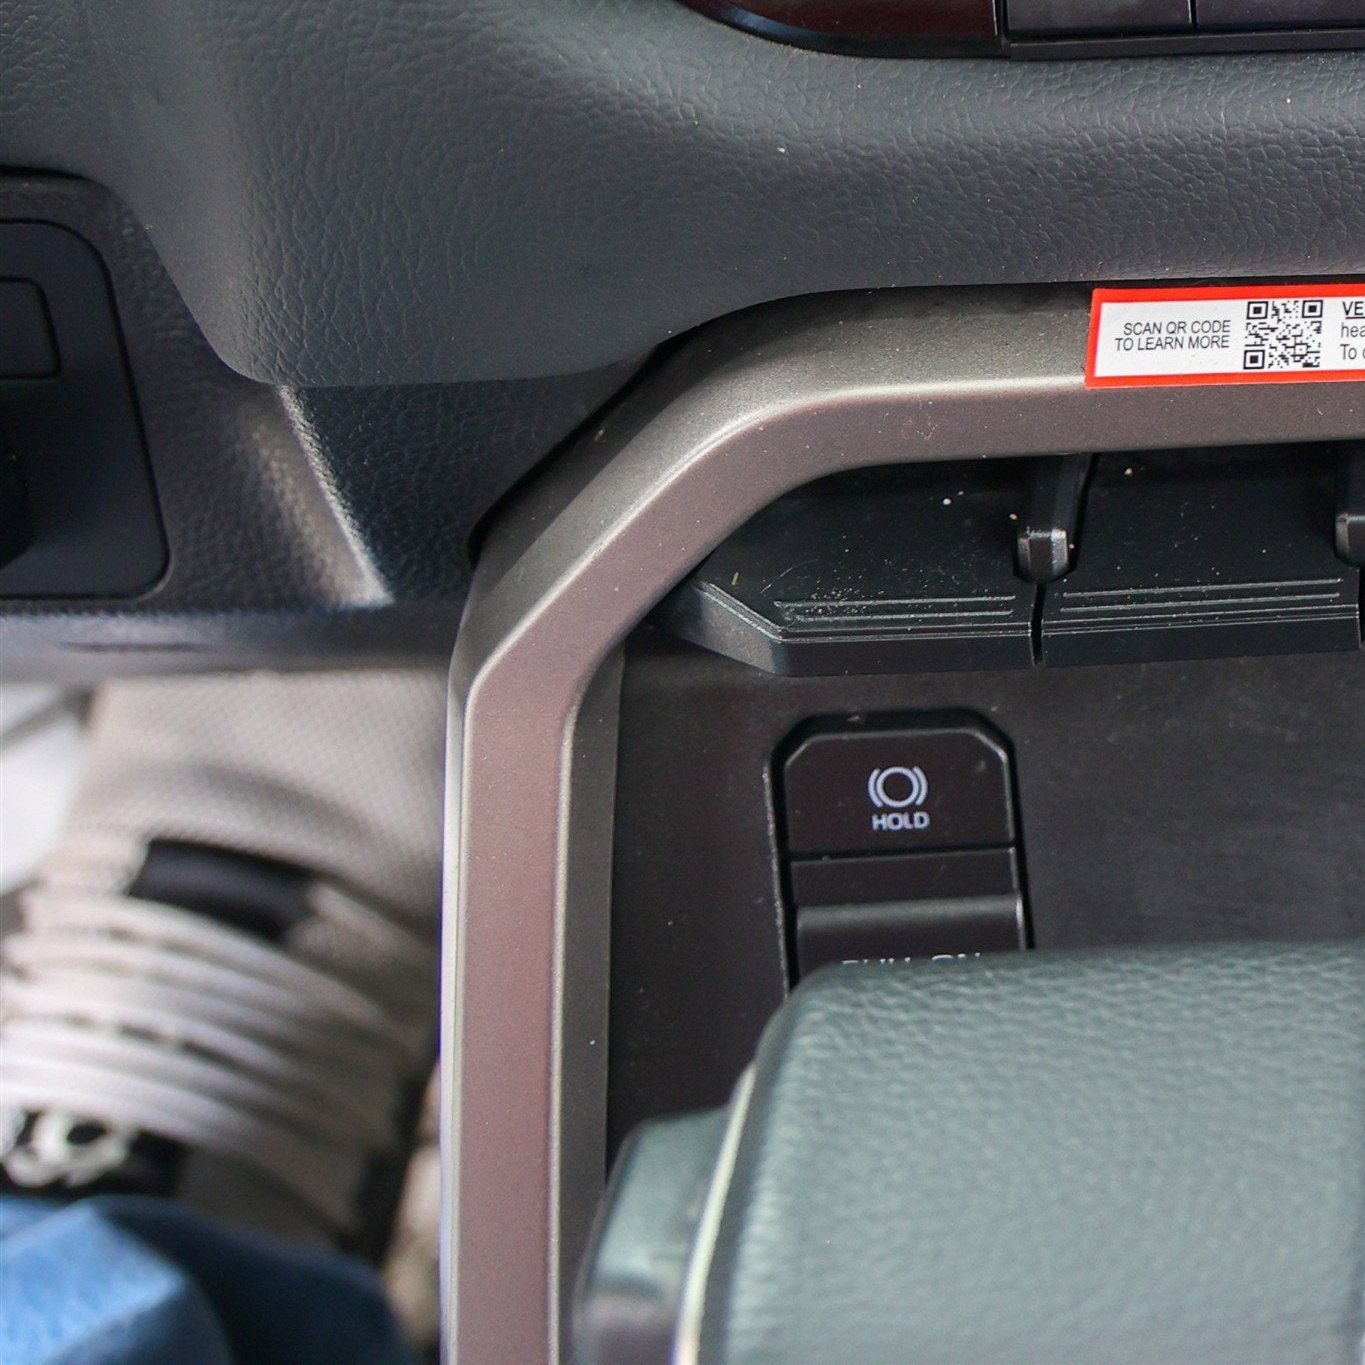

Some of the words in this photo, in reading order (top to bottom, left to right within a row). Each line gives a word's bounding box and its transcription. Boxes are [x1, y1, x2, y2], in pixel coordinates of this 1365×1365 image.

[1123, 321, 1162, 336] SCAN
[1165, 320, 1187, 334] QR
[1191, 319, 1231, 334] CODE
[1115, 337, 1134, 351] TO
[1138, 336, 1184, 351] LEARN
[1188, 335, 1230, 349] MORE
[1340, 343, 1357, 360] To
[872, 811, 930, 831] HOLD
